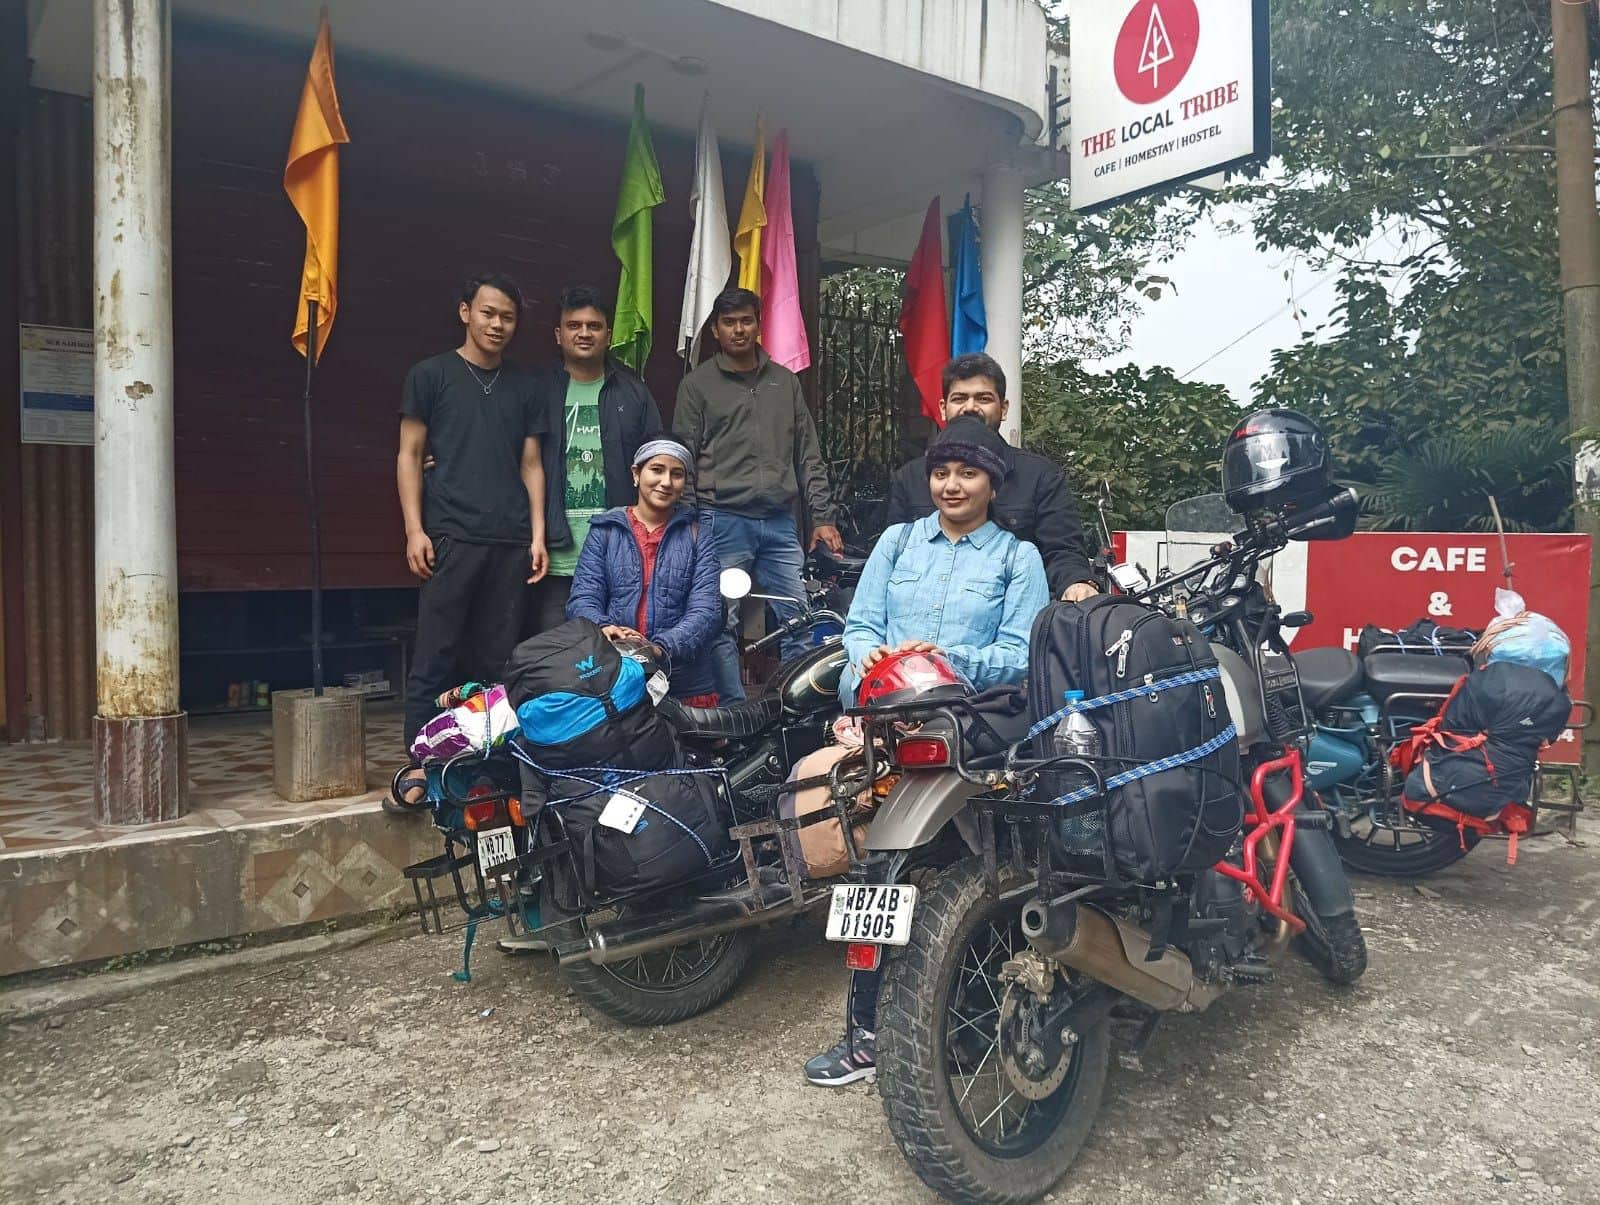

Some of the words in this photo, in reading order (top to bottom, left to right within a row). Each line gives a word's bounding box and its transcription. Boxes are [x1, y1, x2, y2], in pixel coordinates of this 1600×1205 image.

[1081, 128, 1116, 157] THE
[1121, 109, 1174, 143] LOCAL
[1179, 80, 1239, 120] TRIBE
[1094, 161, 1116, 178] CAFE
[1124, 140, 1175, 168] HOMESTAY
[1181, 124, 1222, 148] HOSTEL
[1391, 546, 1487, 572] CAFE
[1427, 591, 1454, 616] &
[846, 887, 900, 912] WB74B
[840, 913, 895, 939] D1905
